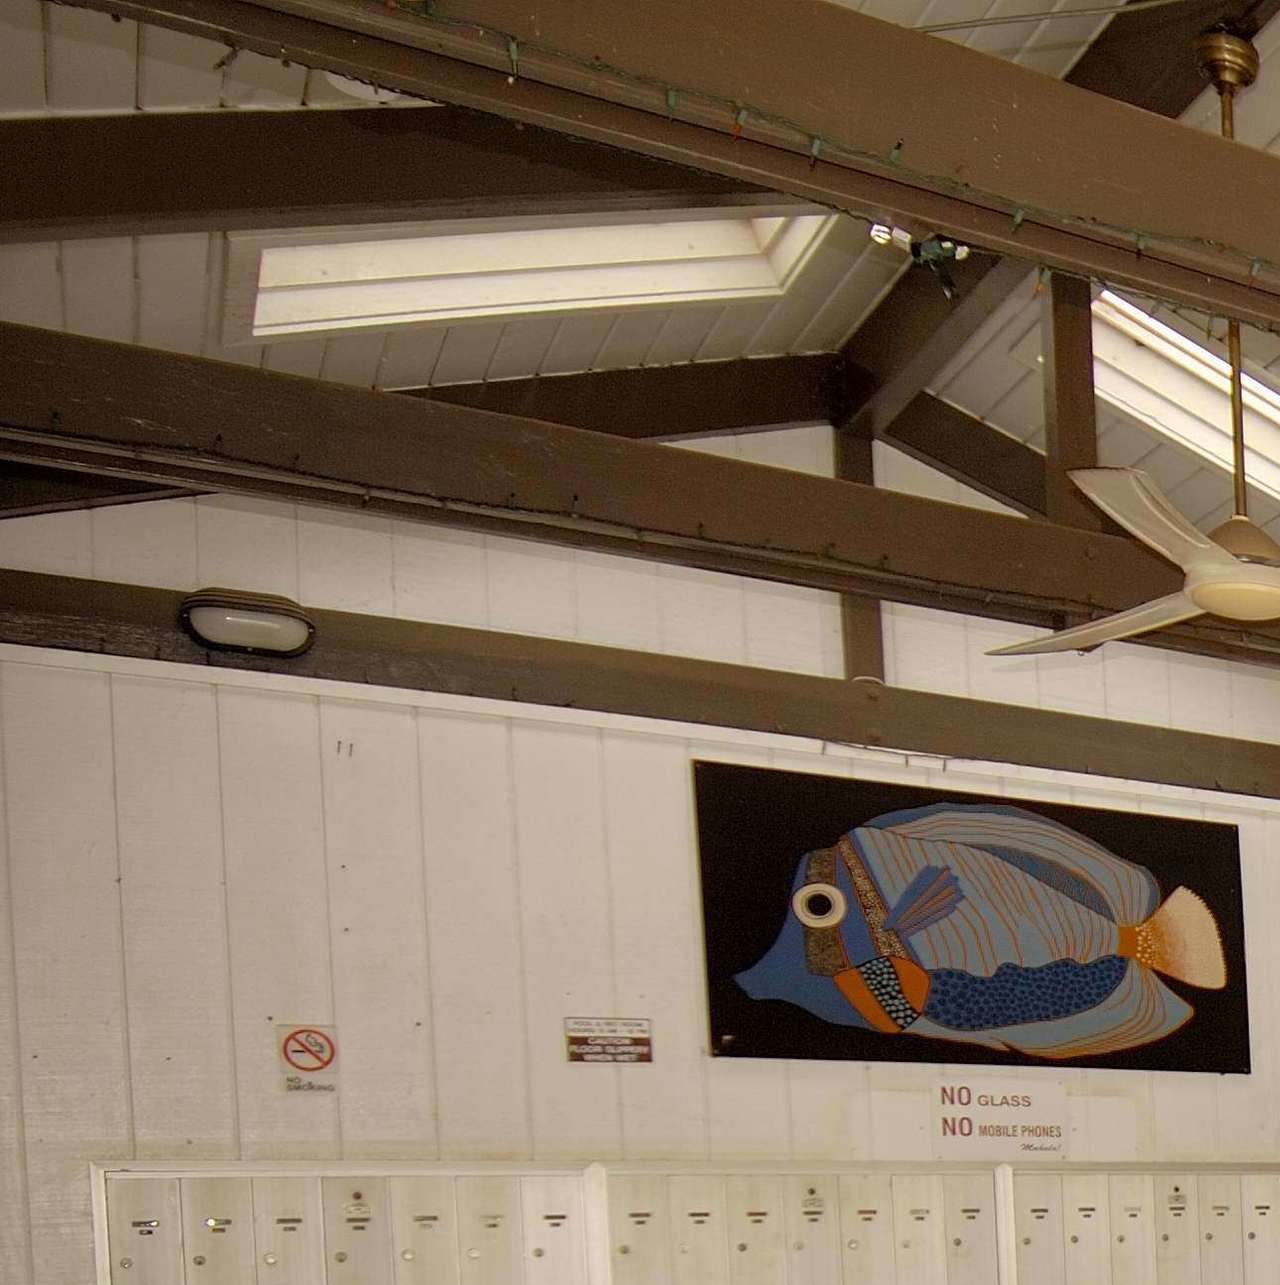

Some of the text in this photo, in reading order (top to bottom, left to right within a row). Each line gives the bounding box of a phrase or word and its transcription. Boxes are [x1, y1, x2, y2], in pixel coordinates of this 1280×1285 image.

[941, 1086, 1032, 1107] NO GLASS
[942, 1117, 1062, 1138] NO MOBILE PHONES
